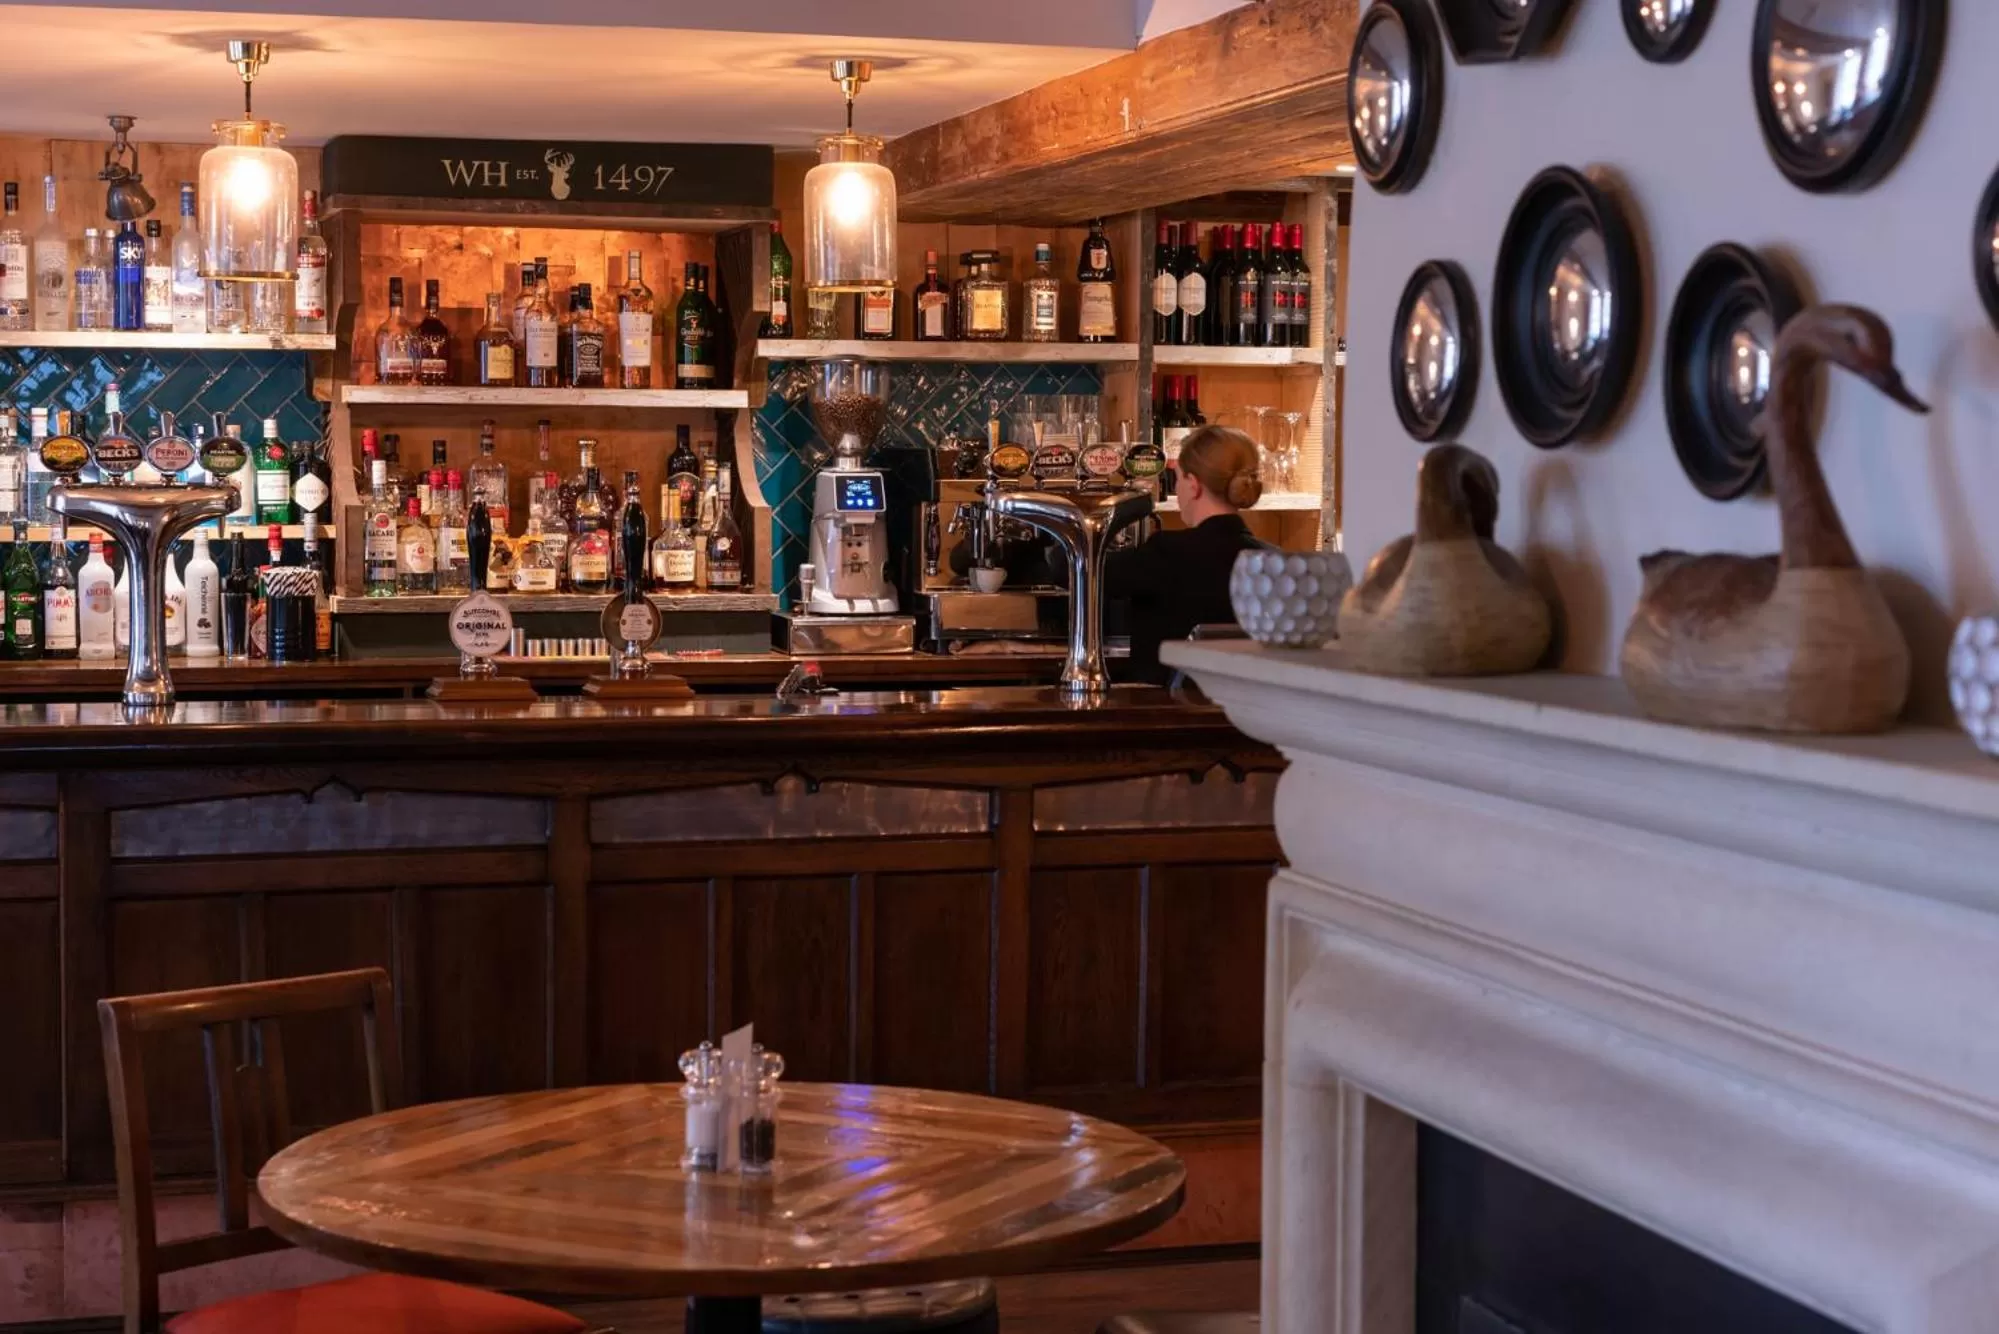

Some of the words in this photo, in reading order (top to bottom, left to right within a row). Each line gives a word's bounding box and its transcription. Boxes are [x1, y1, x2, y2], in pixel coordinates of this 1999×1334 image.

[441, 159, 511, 187] WH
[594, 163, 675, 196] 1497
[98, 449, 138, 458] BECK'S
[155, 448, 187, 458] PERONI
[456, 622, 507, 633] ORIGINAL
